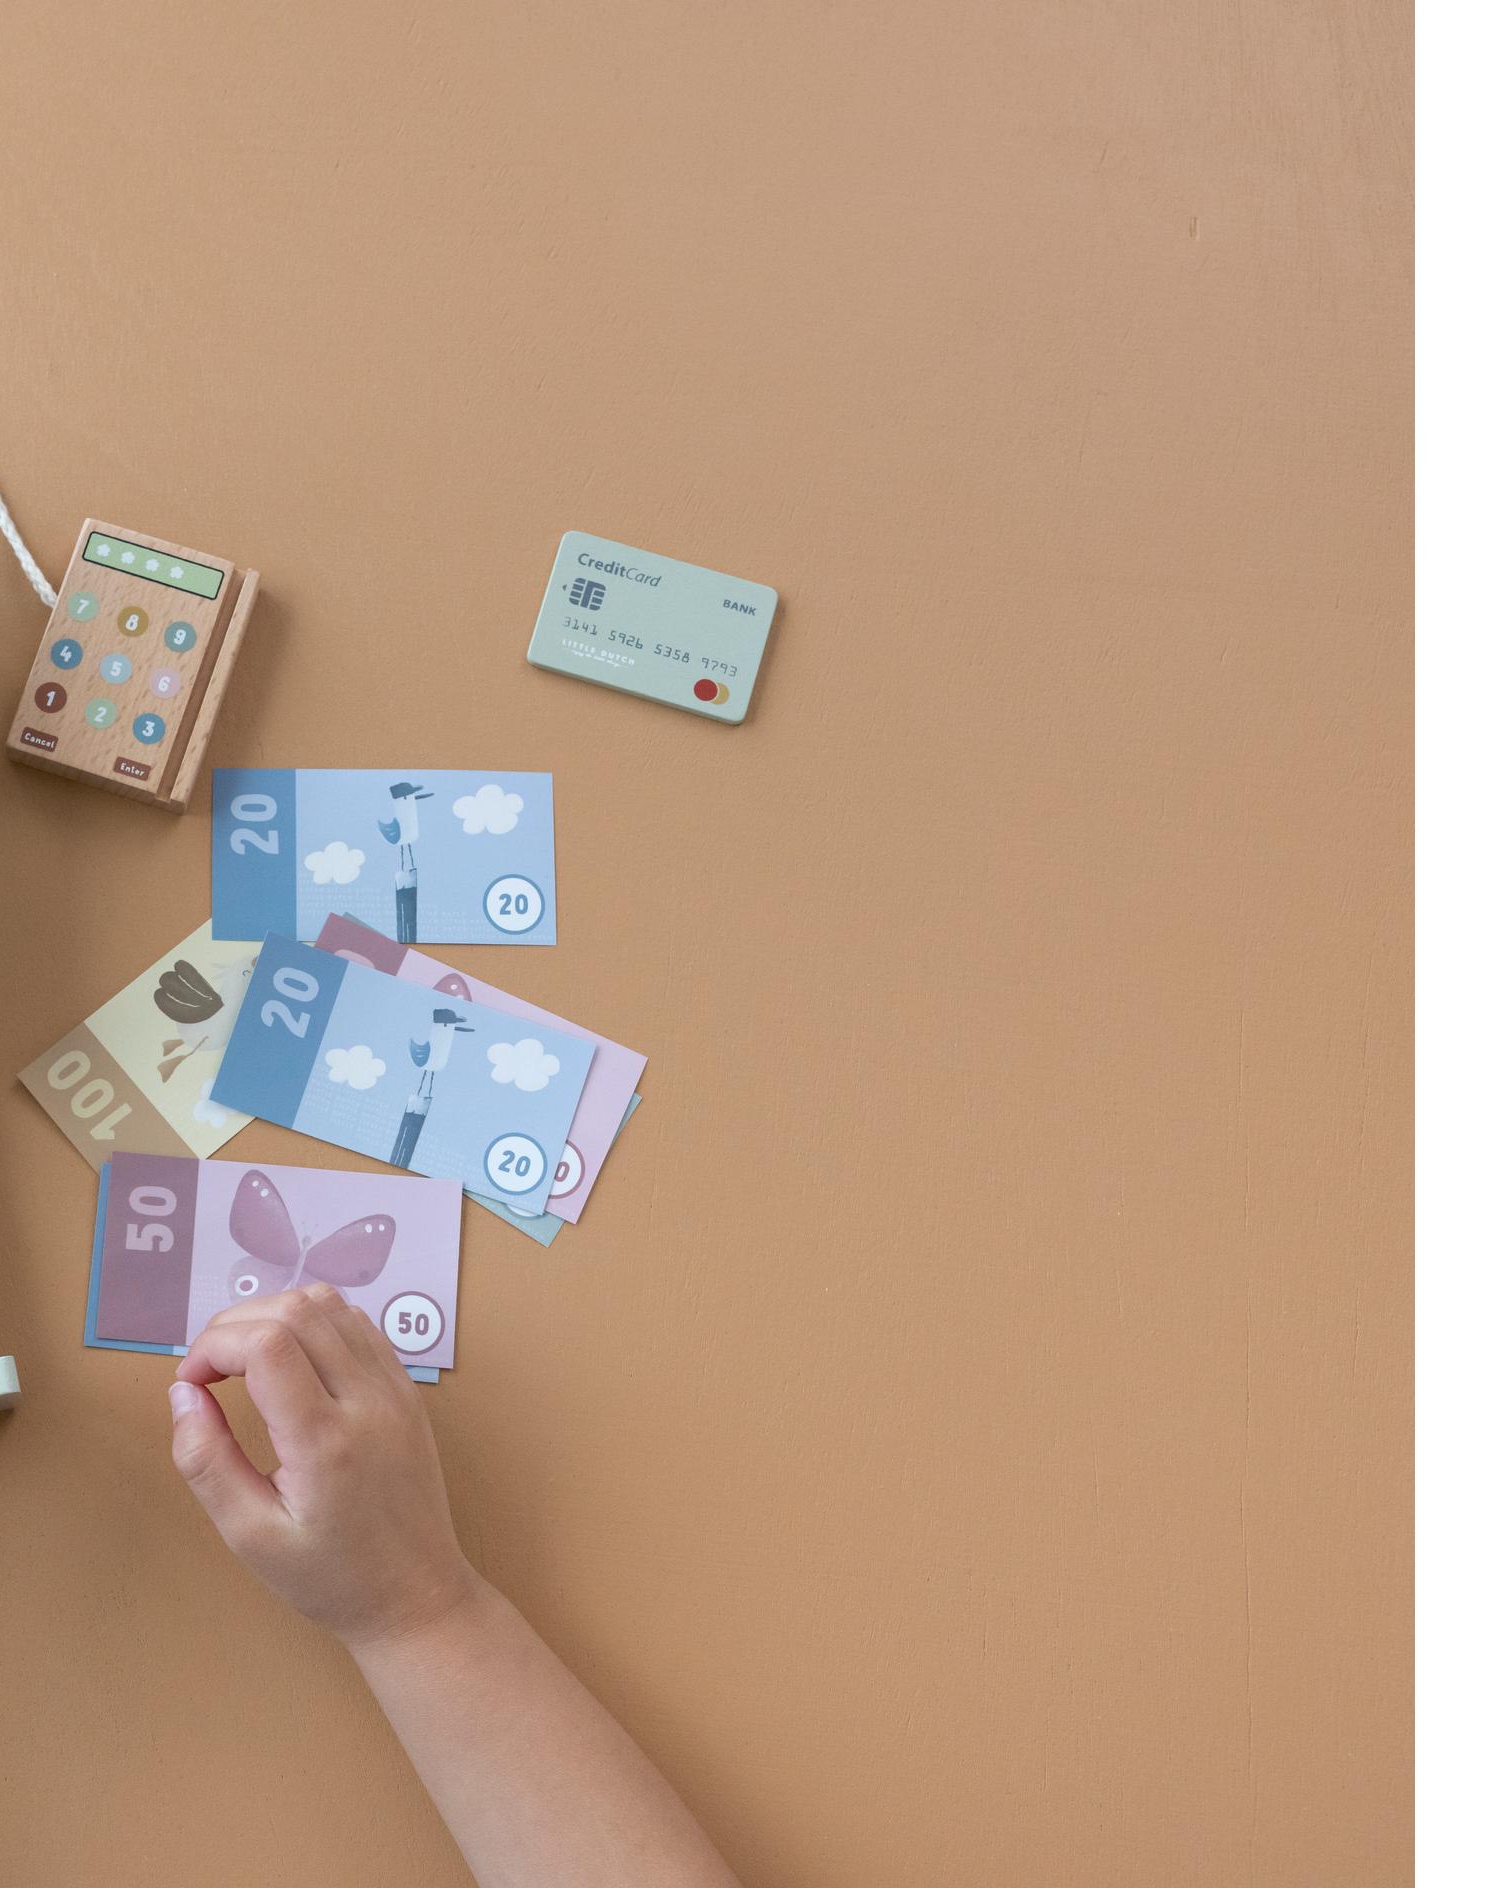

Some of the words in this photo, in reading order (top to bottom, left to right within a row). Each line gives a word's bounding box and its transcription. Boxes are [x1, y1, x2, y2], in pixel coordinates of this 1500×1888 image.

[577, 552, 662, 588] CreditCard
[76, 599, 90, 615] 7
[723, 599, 757, 616] BANK
[125, 614, 139, 631] 8
[173, 628, 187, 646] 9
[60, 645, 72, 663] 4
[562, 638, 596, 654] LITTLE
[600, 649, 635, 666] DUTCH
[563, 616, 598, 636] 3141
[608, 630, 644, 650] 5926
[654, 643, 690, 664] 5358
[701, 657, 738, 677] 9793
[110, 661, 123, 677] 5
[157, 675, 172, 692] 6
[46, 690, 57, 707] 1
[94, 706, 107, 723] 2
[142, 720, 156, 737] 3
[24, 732, 55, 749] Cancel
[120, 762, 145, 777] Enter
[230, 793, 280, 855] 20
[499, 893, 529, 915] 20
[261, 967, 320, 1039] 20
[47, 1050, 132, 1140] 100
[498, 1150, 531, 1177] 20
[125, 1185, 178, 1253] 50
[397, 1312, 430, 1336] 50
